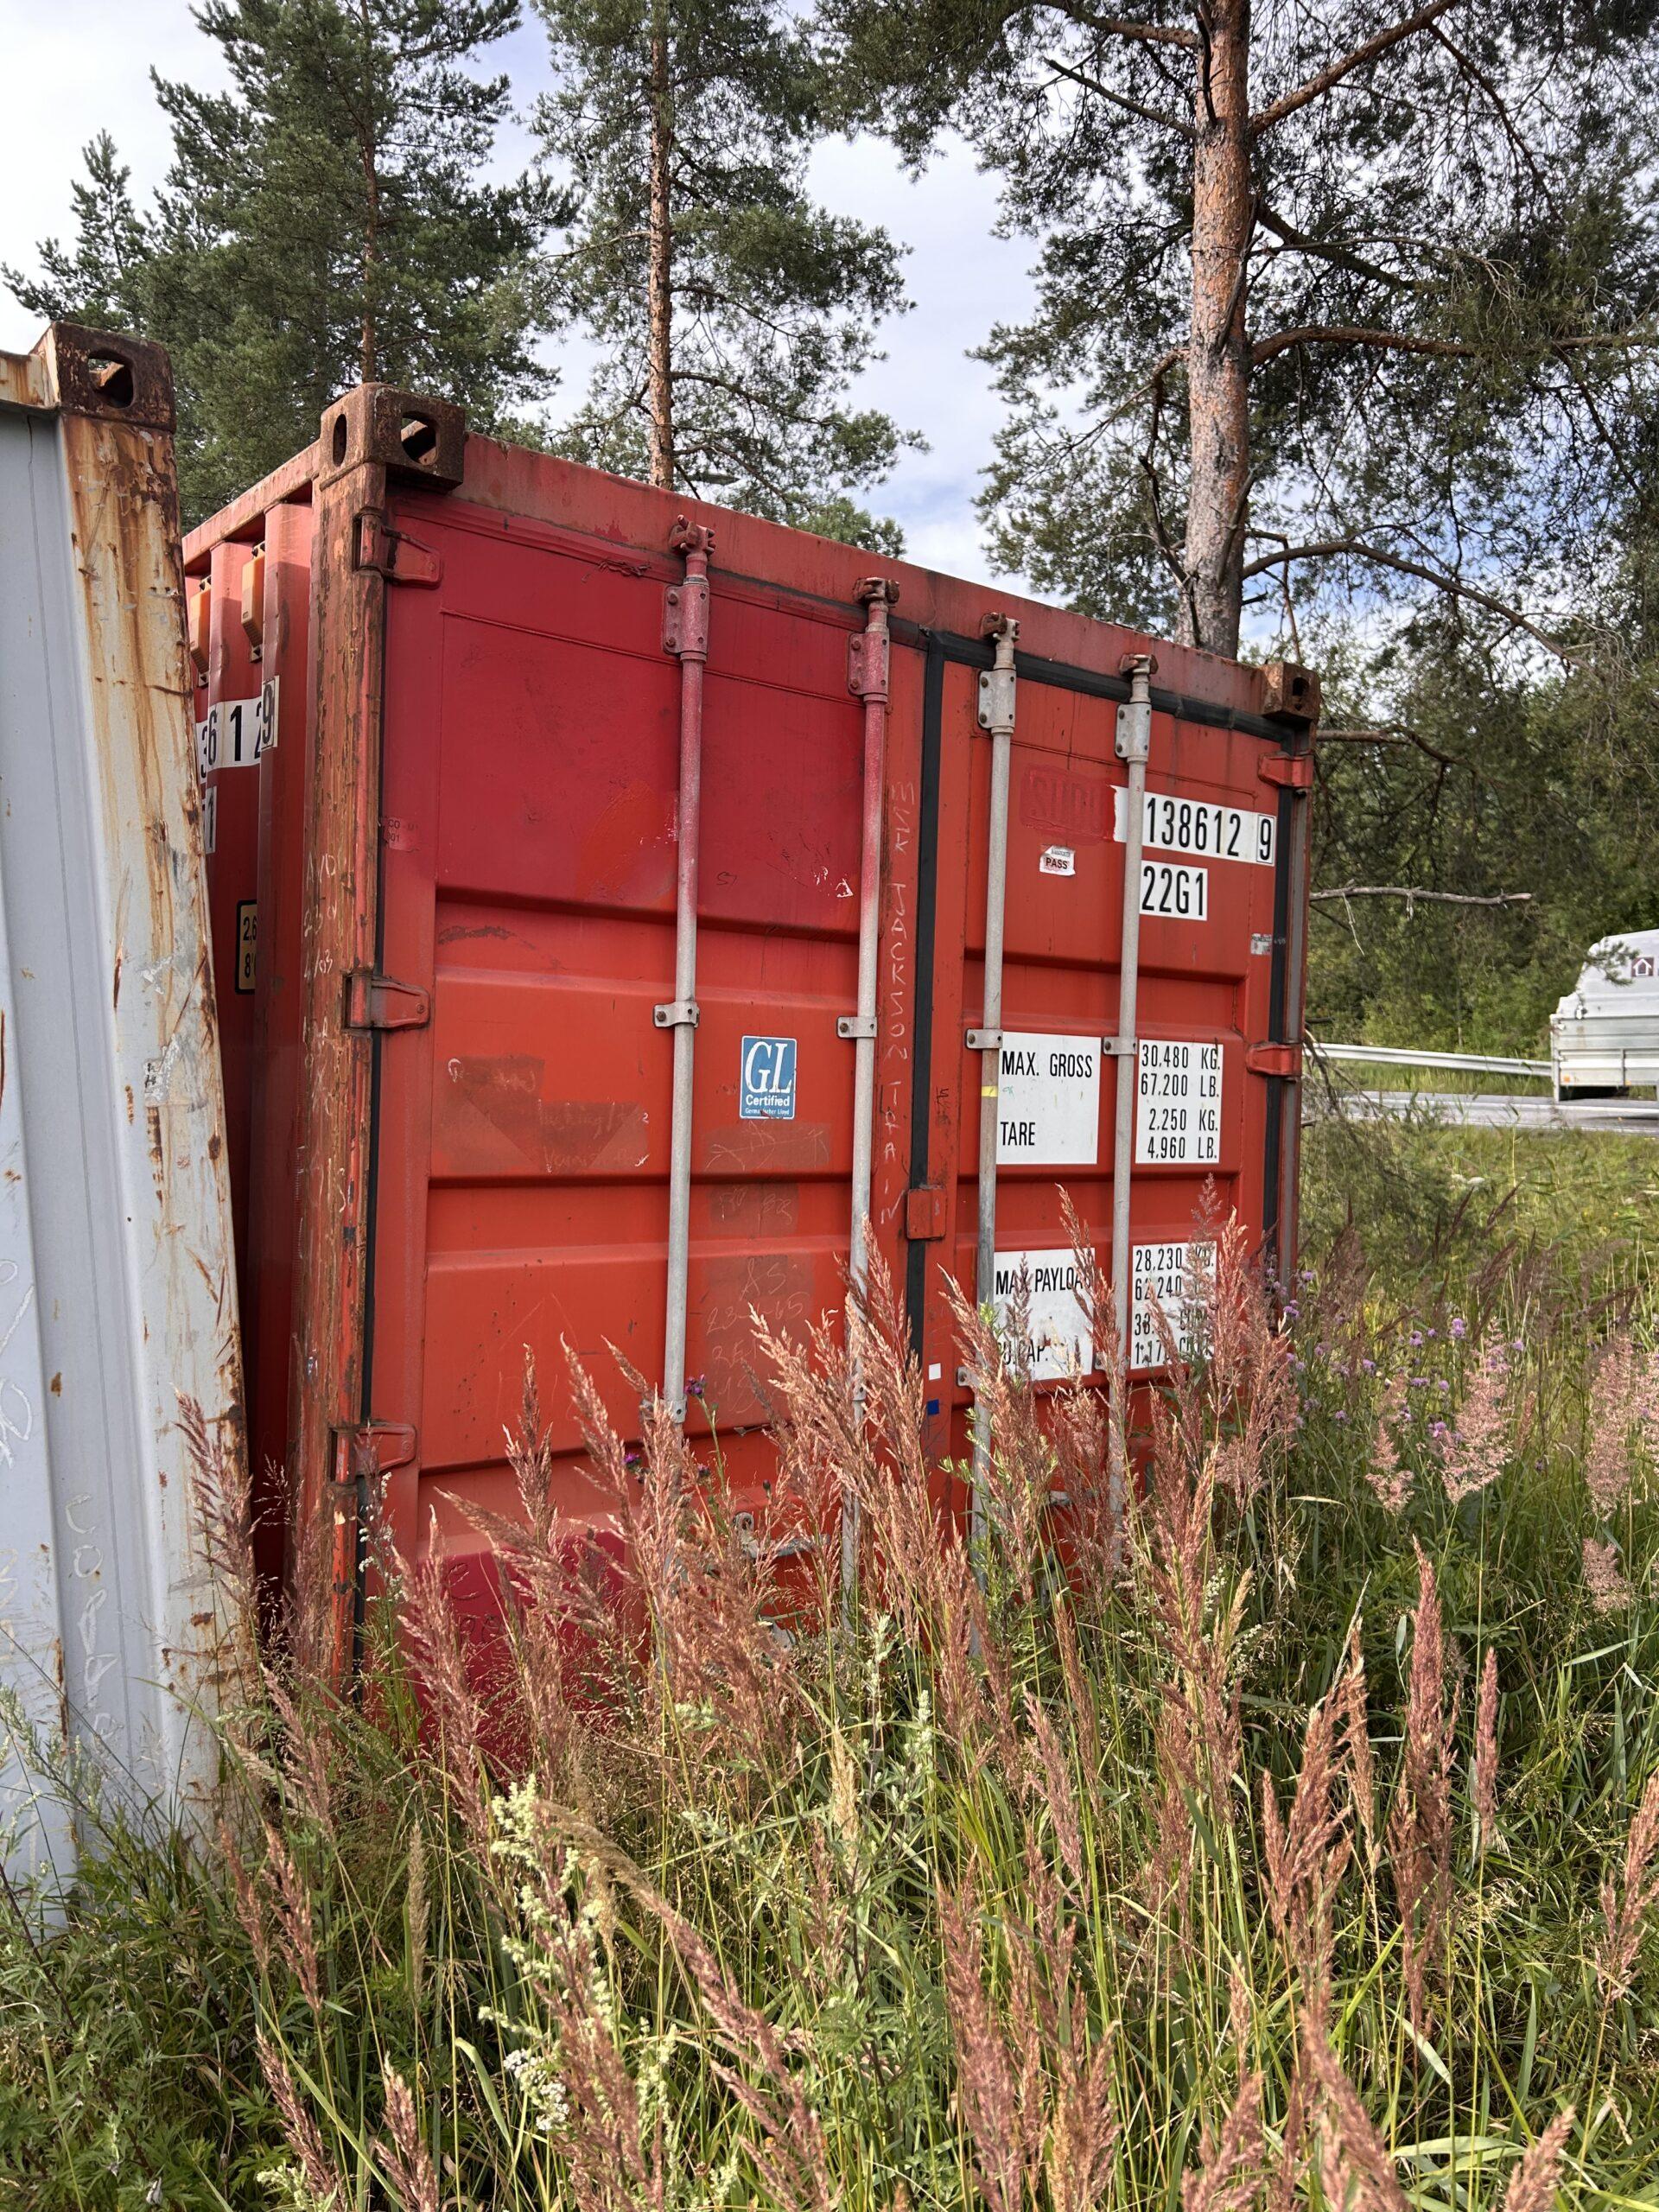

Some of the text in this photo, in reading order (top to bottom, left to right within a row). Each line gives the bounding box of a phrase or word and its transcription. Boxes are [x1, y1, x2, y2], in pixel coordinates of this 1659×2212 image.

[1147, 797, 1241, 857] 138612
[1260, 817, 1272, 861] 9
[1046, 856, 1068, 870] PASS
[1141, 865, 1204, 916] 22G1
[745, 1041, 792, 1094] GL
[1001, 1050, 1092, 1078] MAX. GROSS
[1141, 1044, 1220, 1070] 30,480 KG.
[1141, 1072, 1219, 1097] 67,200 LB.
[745, 1094, 791, 1107] Certified
[1148, 1108, 1218, 1131] 2,250 KG.
[1000, 1121, 1036, 1146] TARE
[1147, 1136, 1217, 1159] 4,960 LB.
[1135, 1248, 1182, 1272] 28,230
